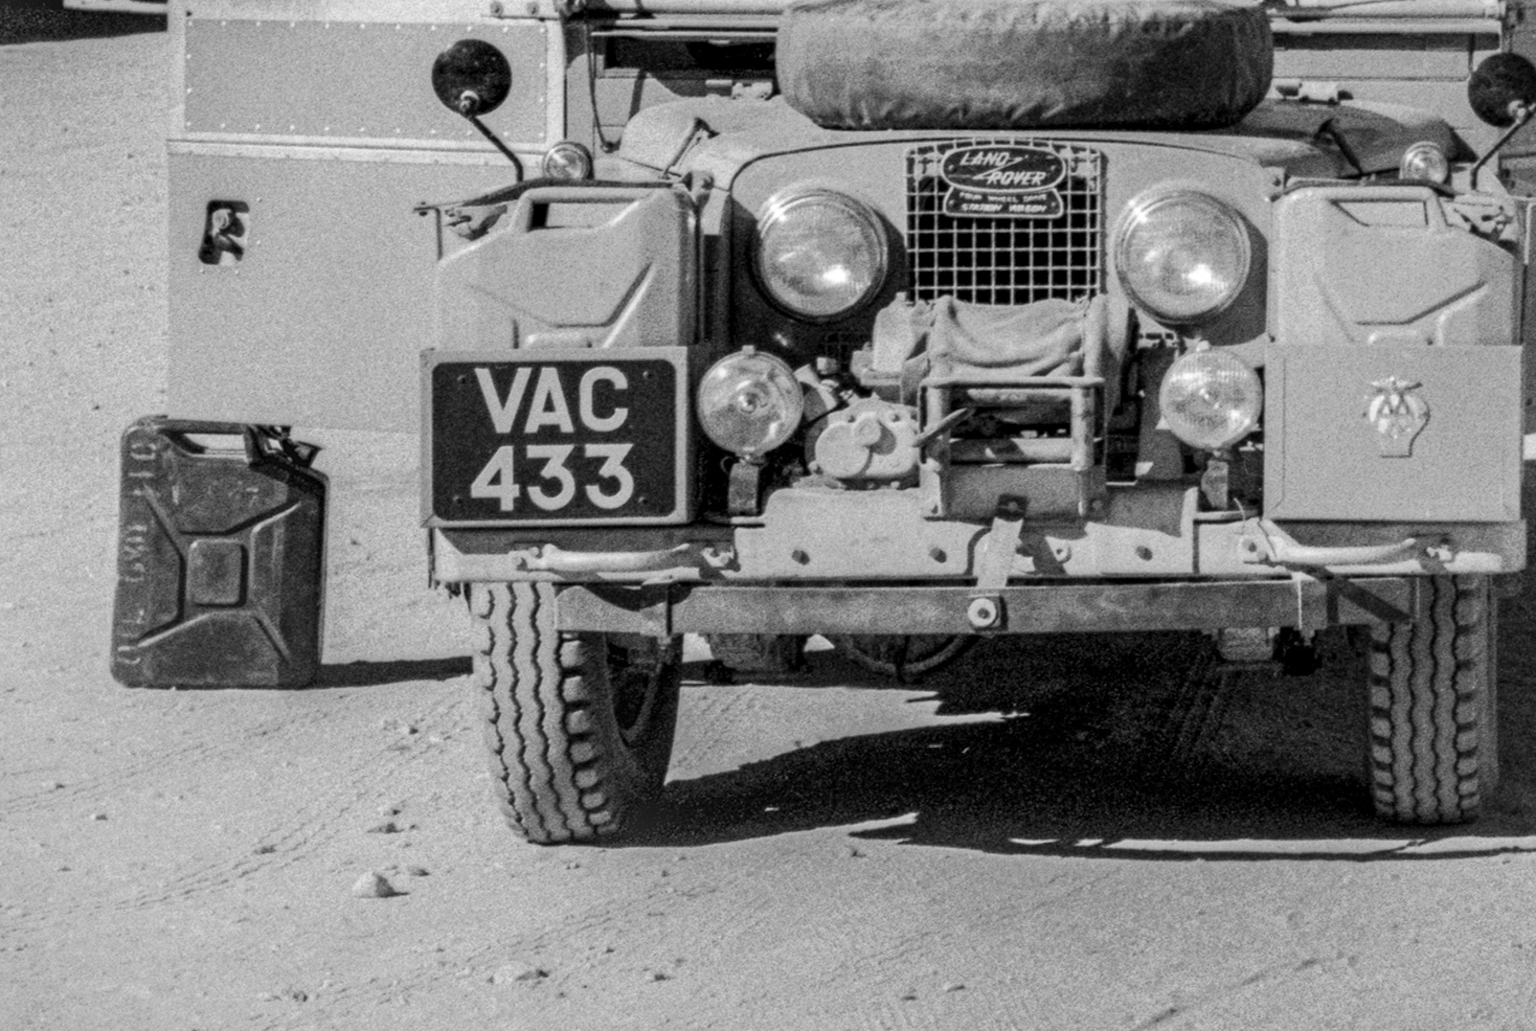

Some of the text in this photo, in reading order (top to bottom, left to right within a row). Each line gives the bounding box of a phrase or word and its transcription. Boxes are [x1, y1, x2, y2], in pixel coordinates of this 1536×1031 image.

[959, 151, 1010, 166] LAND
[986, 171, 1047, 186] ROVER
[961, 203, 1048, 213] STATION WAGON
[474, 365, 628, 434] VAC
[470, 443, 635, 512] 433
